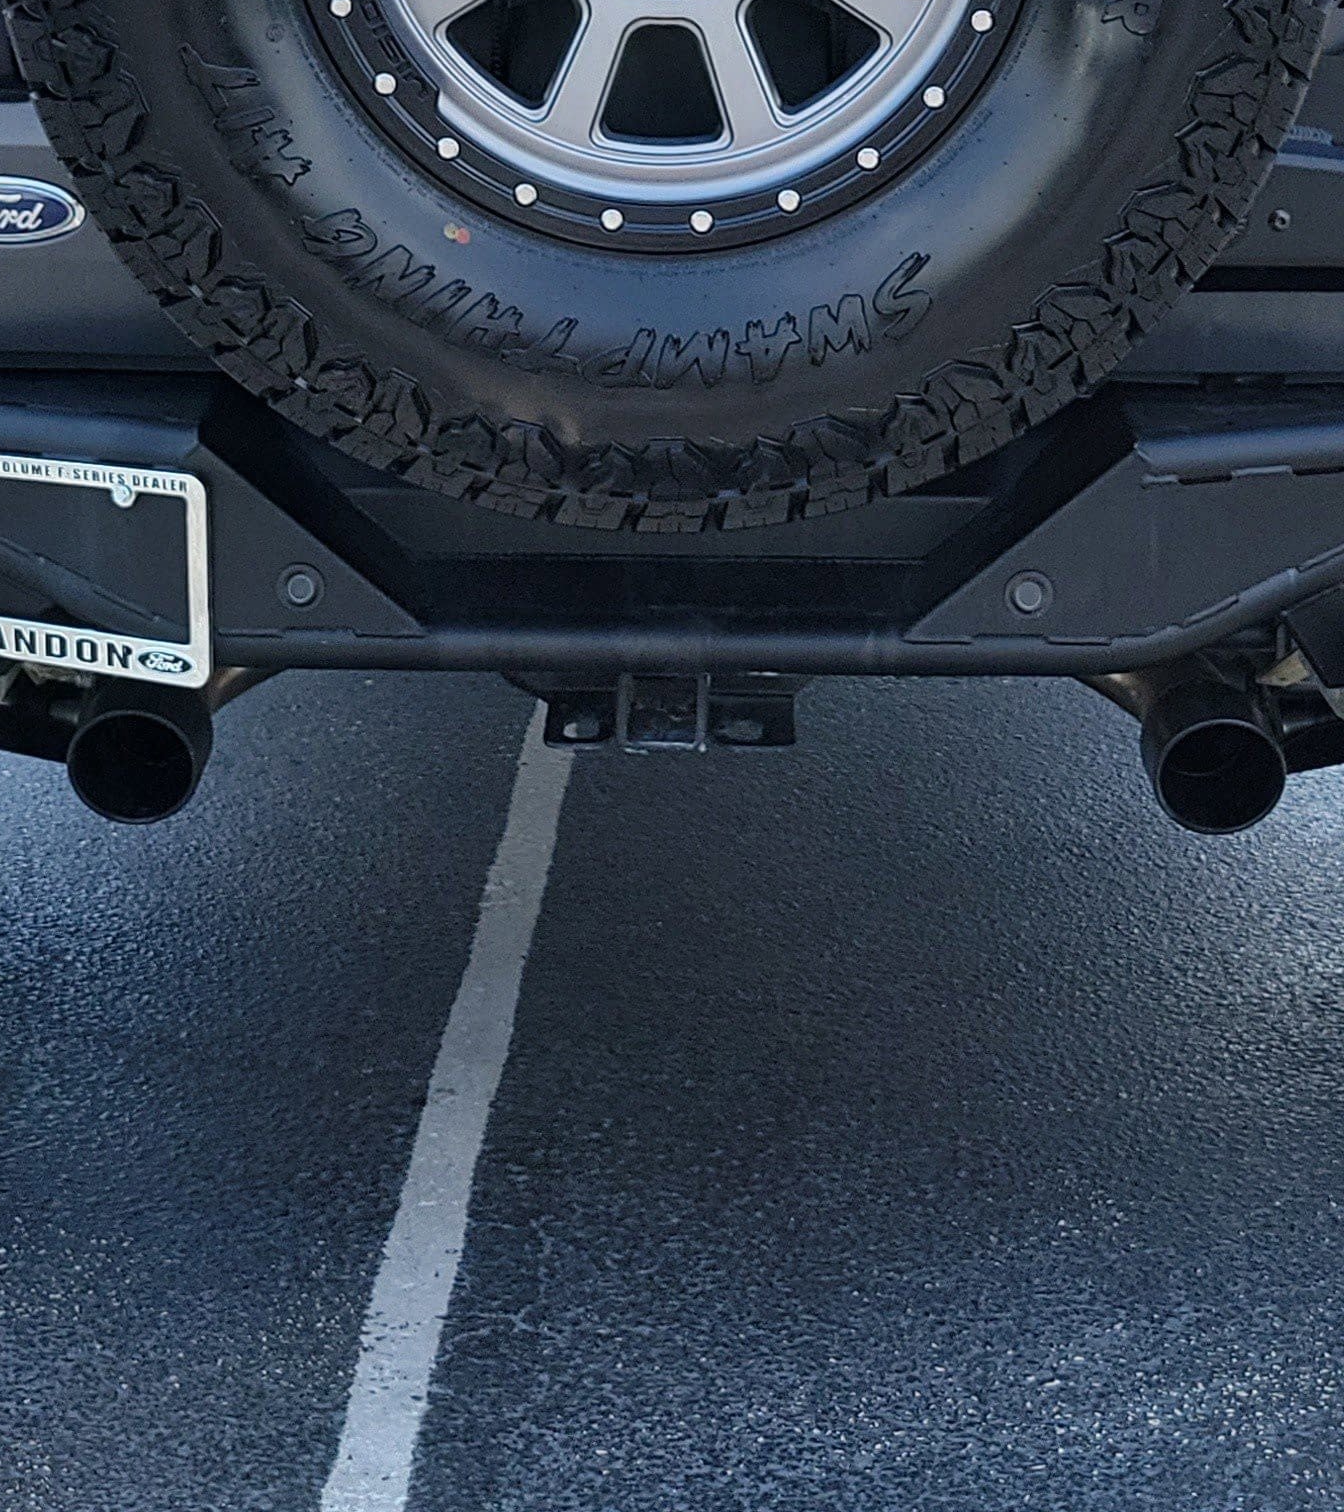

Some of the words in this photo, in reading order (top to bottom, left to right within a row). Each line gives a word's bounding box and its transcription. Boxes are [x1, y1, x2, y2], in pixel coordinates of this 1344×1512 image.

[300, 207, 581, 373] THING
[581, 251, 933, 390] SWAMP
[132, 474, 189, 493] DEALER
[145, 651, 183, 673] Ford
